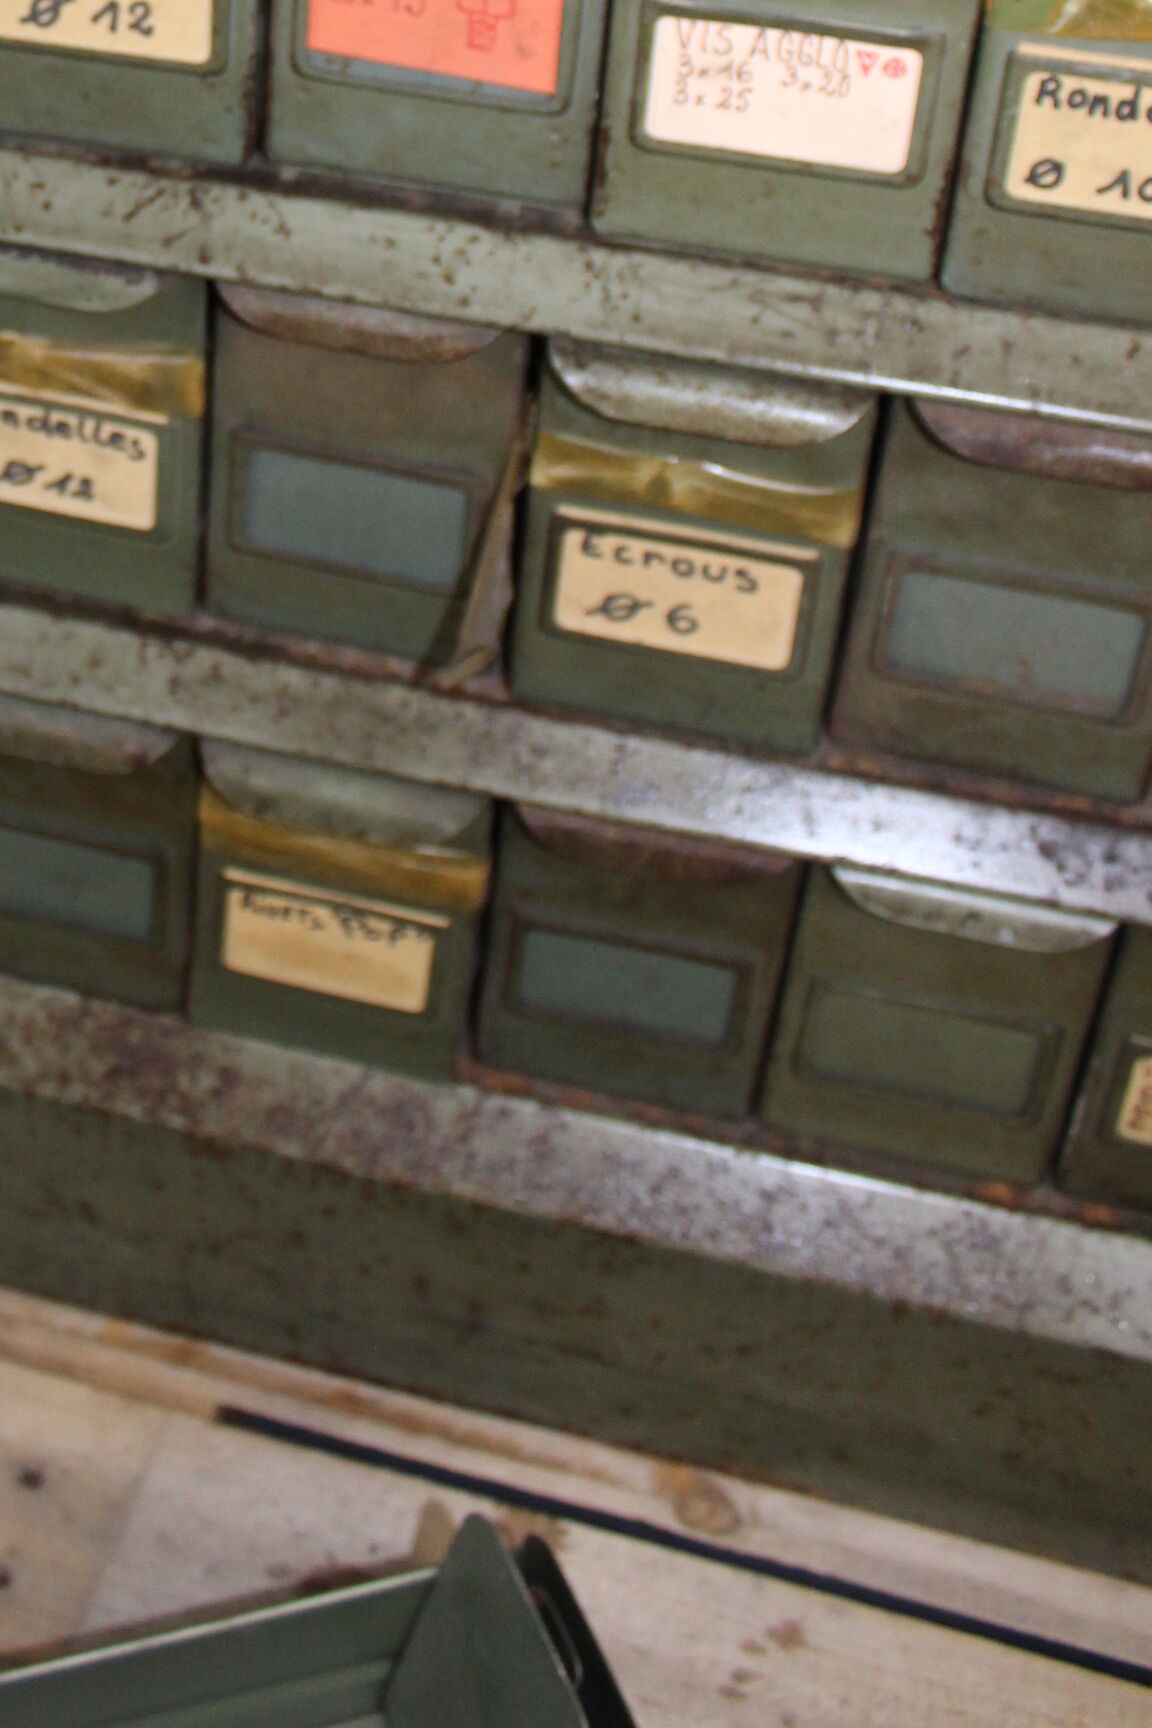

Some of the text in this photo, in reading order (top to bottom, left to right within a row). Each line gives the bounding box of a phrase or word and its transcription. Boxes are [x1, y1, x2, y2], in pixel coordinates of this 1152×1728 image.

[91, 0, 156, 37] 12
[674, 19, 733, 57] VIS
[1035, 74, 1152, 121] Rond
[664, 603, 700, 636] 6
